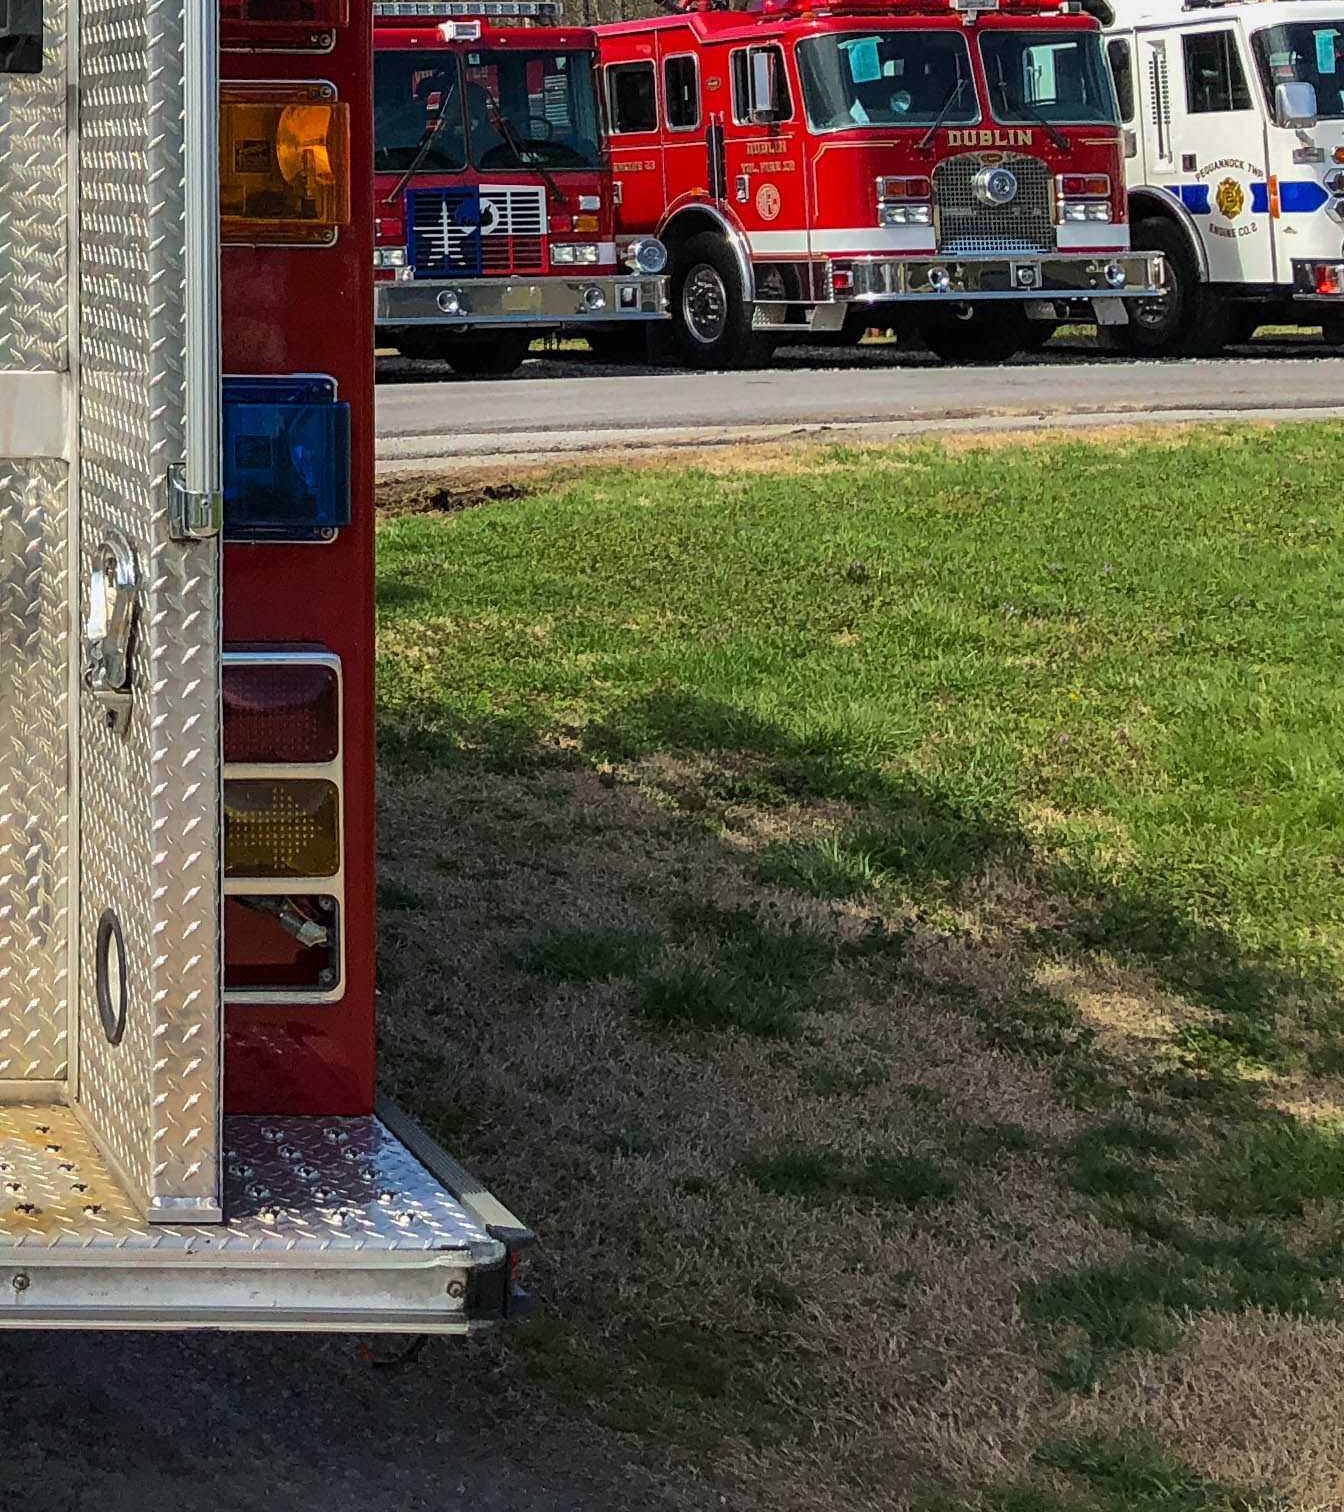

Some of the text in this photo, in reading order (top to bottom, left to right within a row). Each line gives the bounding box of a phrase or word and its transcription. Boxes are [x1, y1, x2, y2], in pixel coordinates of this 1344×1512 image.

[947, 129, 1032, 147] DUBLIN
[1195, 158, 1245, 183] PEQUANNOCK
[1251, 222, 1257, 233] 2
